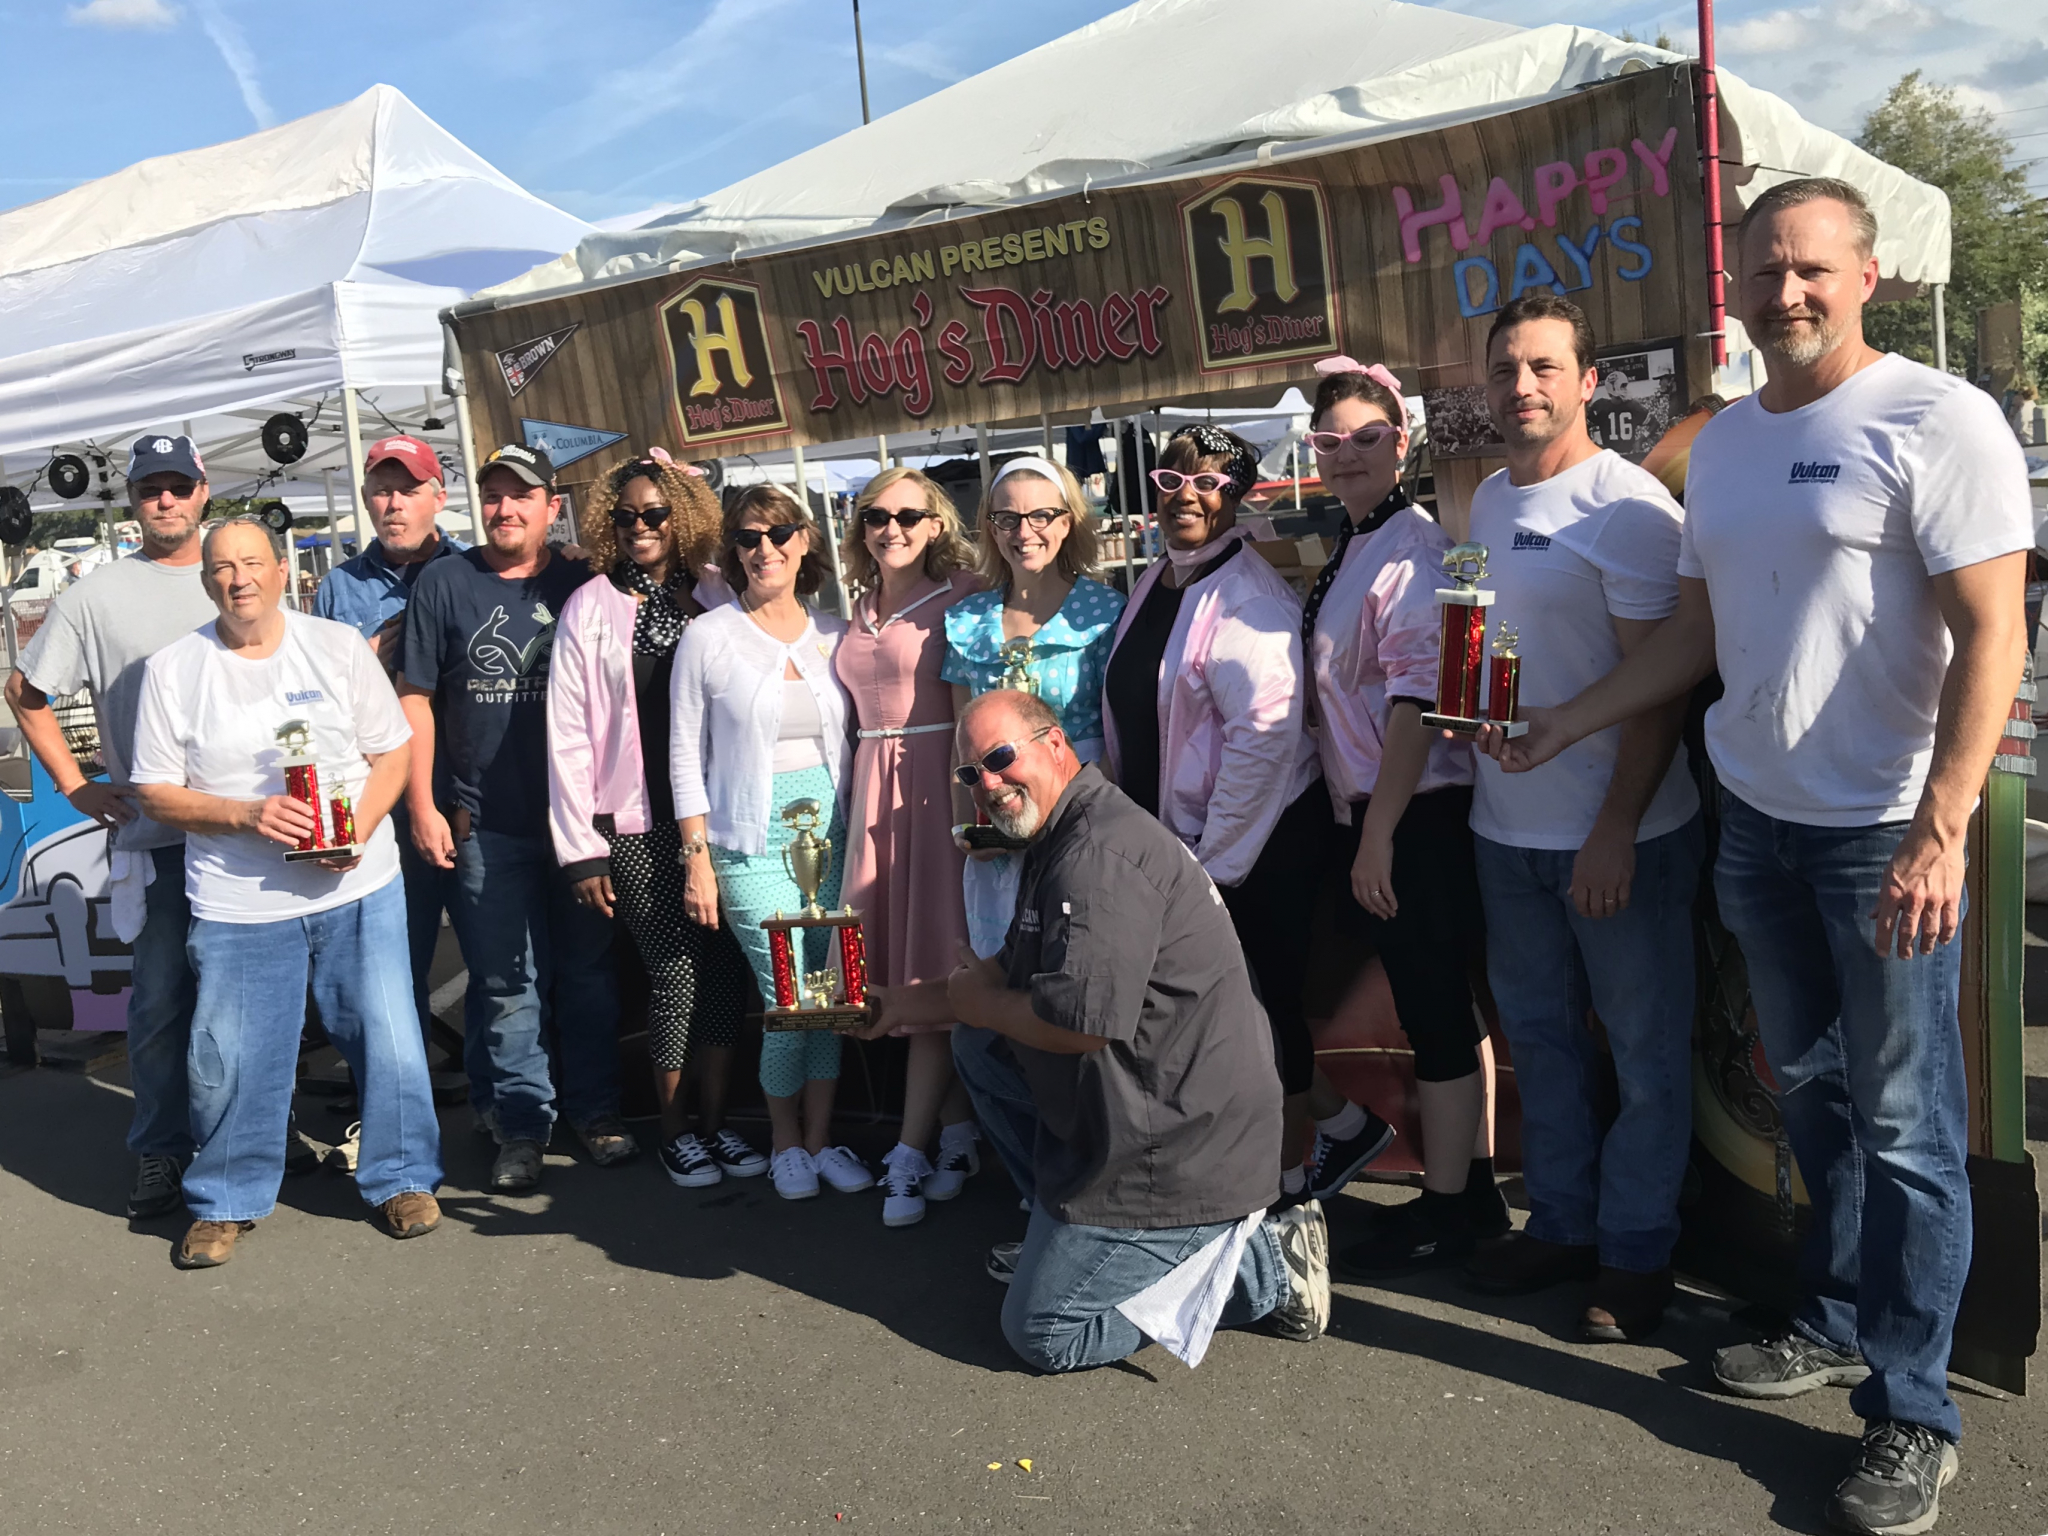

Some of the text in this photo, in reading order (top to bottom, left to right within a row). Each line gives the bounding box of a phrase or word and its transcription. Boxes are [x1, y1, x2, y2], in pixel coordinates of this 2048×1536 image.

[1392, 126, 1678, 263] HAPPY
[813, 216, 1110, 298] VULCAN PRESENTS
[1453, 216, 1653, 318] DAYS
[1210, 314, 1324, 354] Hog's Diner
[243, 348, 296, 371] STRONGWAY
[518, 336, 555, 369] BROWN
[796, 285, 1170, 417] Hog's Diner
[686, 397, 774, 430] Hog's Diner
[1608, 411, 1632, 440] 16
[1790, 461, 1840, 479] Vulcan
[1513, 531, 1551, 547] Vulcan
[285, 689, 324, 702] Vulcan
[467, 676, 548, 691] REALTR
[475, 690, 548, 703] OUTFITTE
